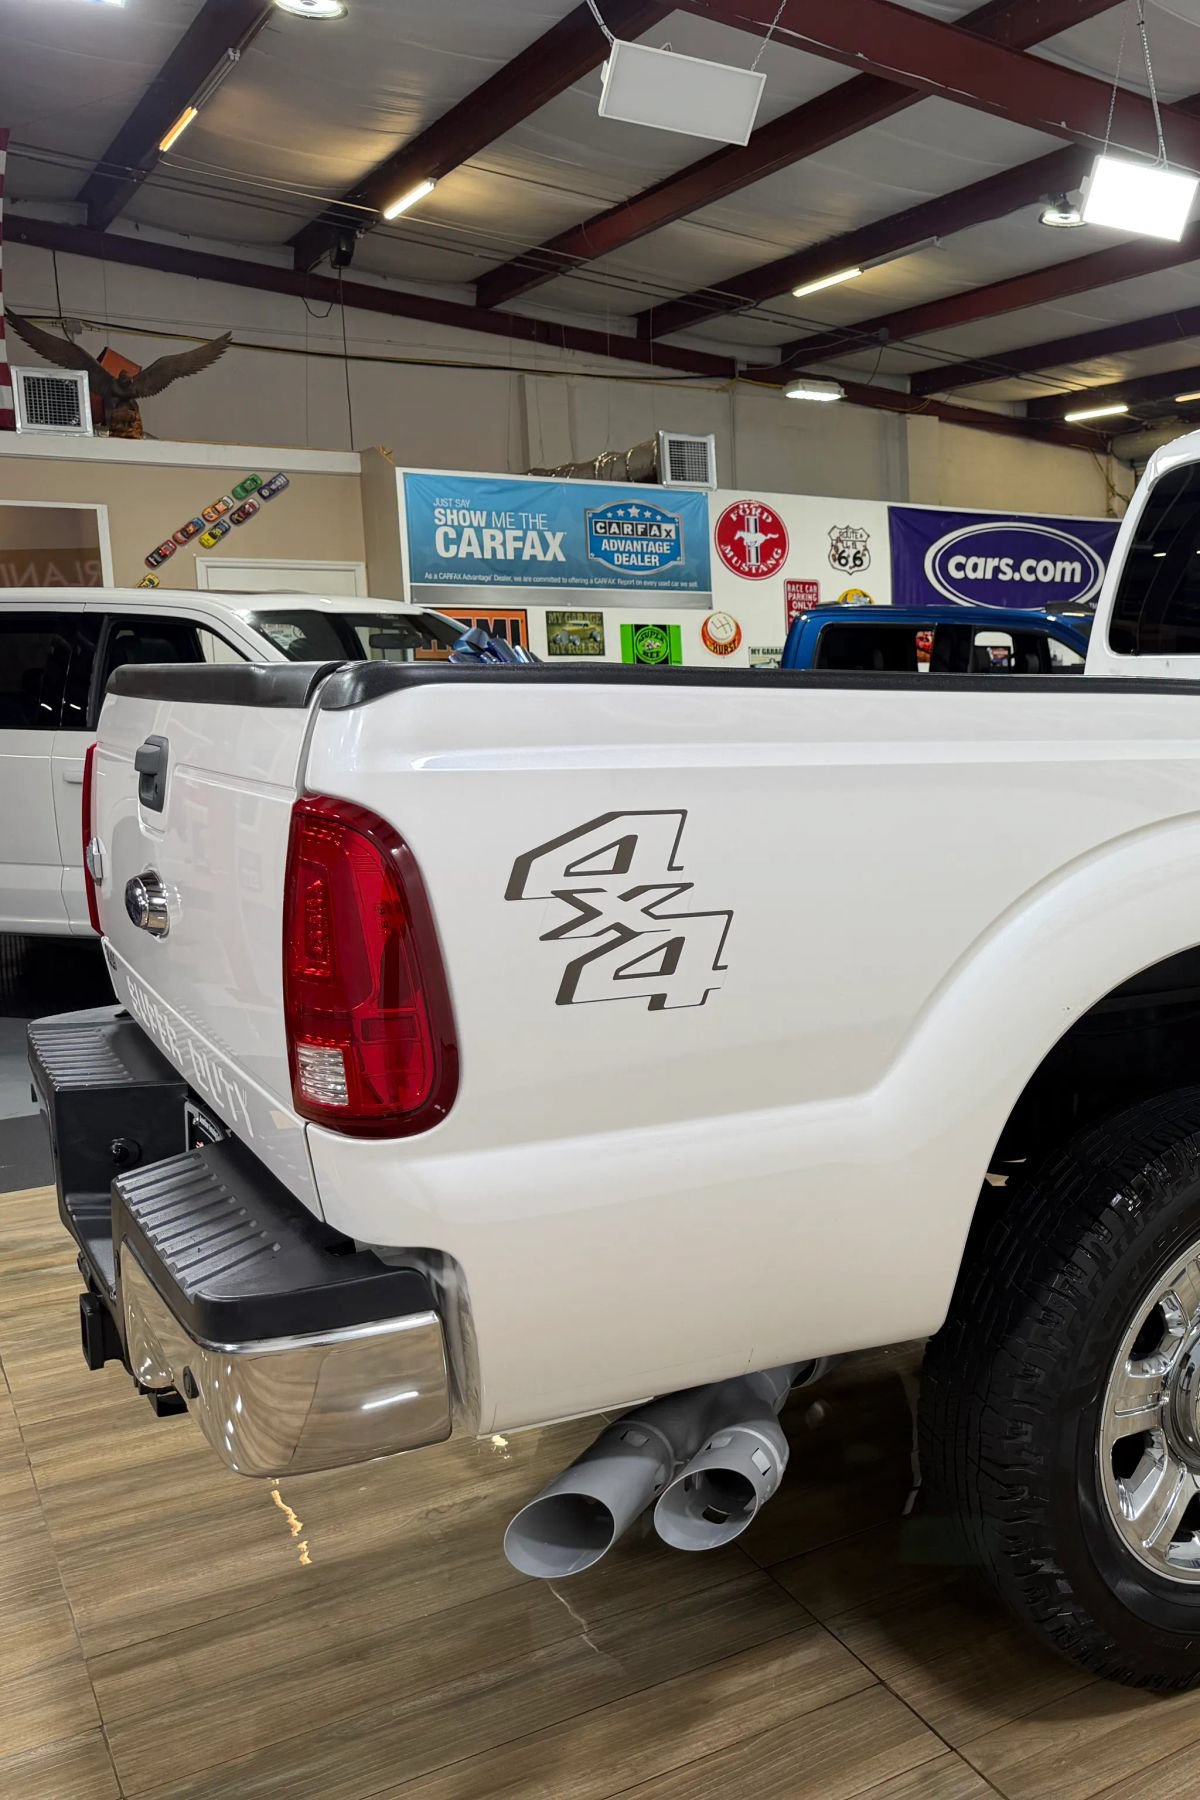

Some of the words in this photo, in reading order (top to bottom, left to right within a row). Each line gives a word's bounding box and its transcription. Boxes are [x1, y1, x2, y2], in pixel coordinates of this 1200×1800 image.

[433, 497, 452, 508] JUST
[455, 498, 471, 509] SAY
[434, 508, 487, 528] SHOW
[492, 511, 516, 529] ME
[518, 512, 549, 530] THE
[730, 505, 773, 523] FORD
[595, 521, 673, 539] CARFAX
[435, 526, 567, 562] CARFAX
[601, 539, 671, 554] ADVANTAGE
[614, 552, 660, 567] DEALER
[720, 544, 782, 574] MUSTANG
[838, 549, 864, 568] 66
[947, 552, 1082, 584] cars.com
[787, 583, 804, 593] RACE
[804, 584, 817, 594] CAR
[787, 592, 817, 602] PARKING
[548, 612, 562, 623] MY
[564, 612, 602, 624] GARAGE
[550, 642, 565, 654] MY
[712, 639, 737, 655] HURST
[126, 975, 184, 1067] SUPER
[188, 1038, 254, 1139] DUTY
